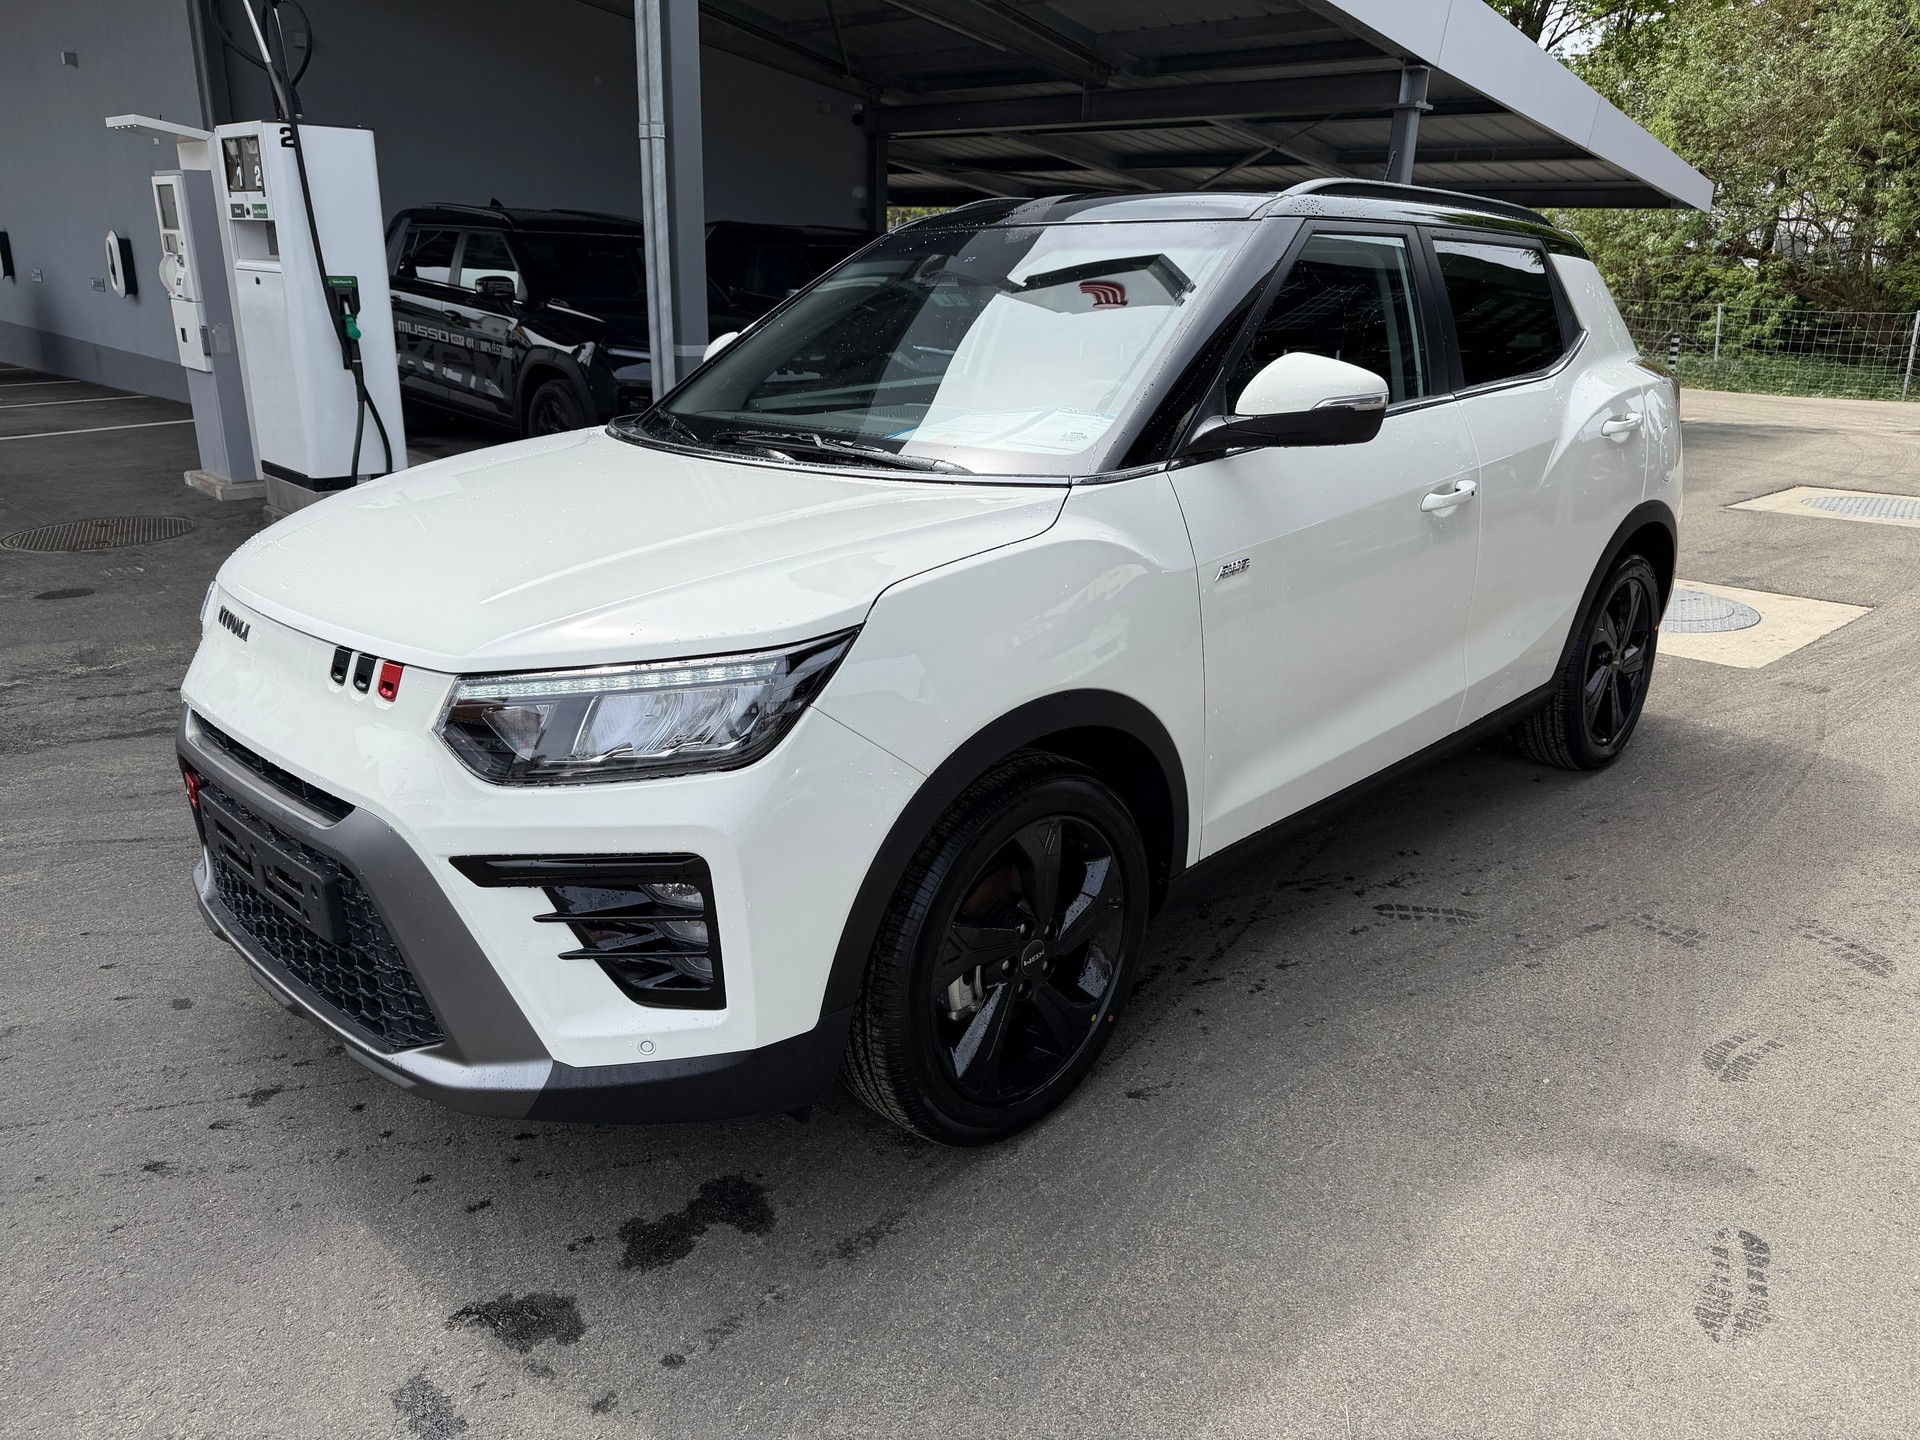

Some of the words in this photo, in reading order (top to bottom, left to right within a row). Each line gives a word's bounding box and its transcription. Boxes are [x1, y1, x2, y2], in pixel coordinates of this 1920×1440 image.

[279, 127, 295, 147] 2
[236, 166, 243, 187] 1
[254, 165, 262, 187] 2
[398, 320, 449, 342] MUSSO
[1214, 558, 1250, 581] AWD
[1023, 950, 1044, 967] KGM
